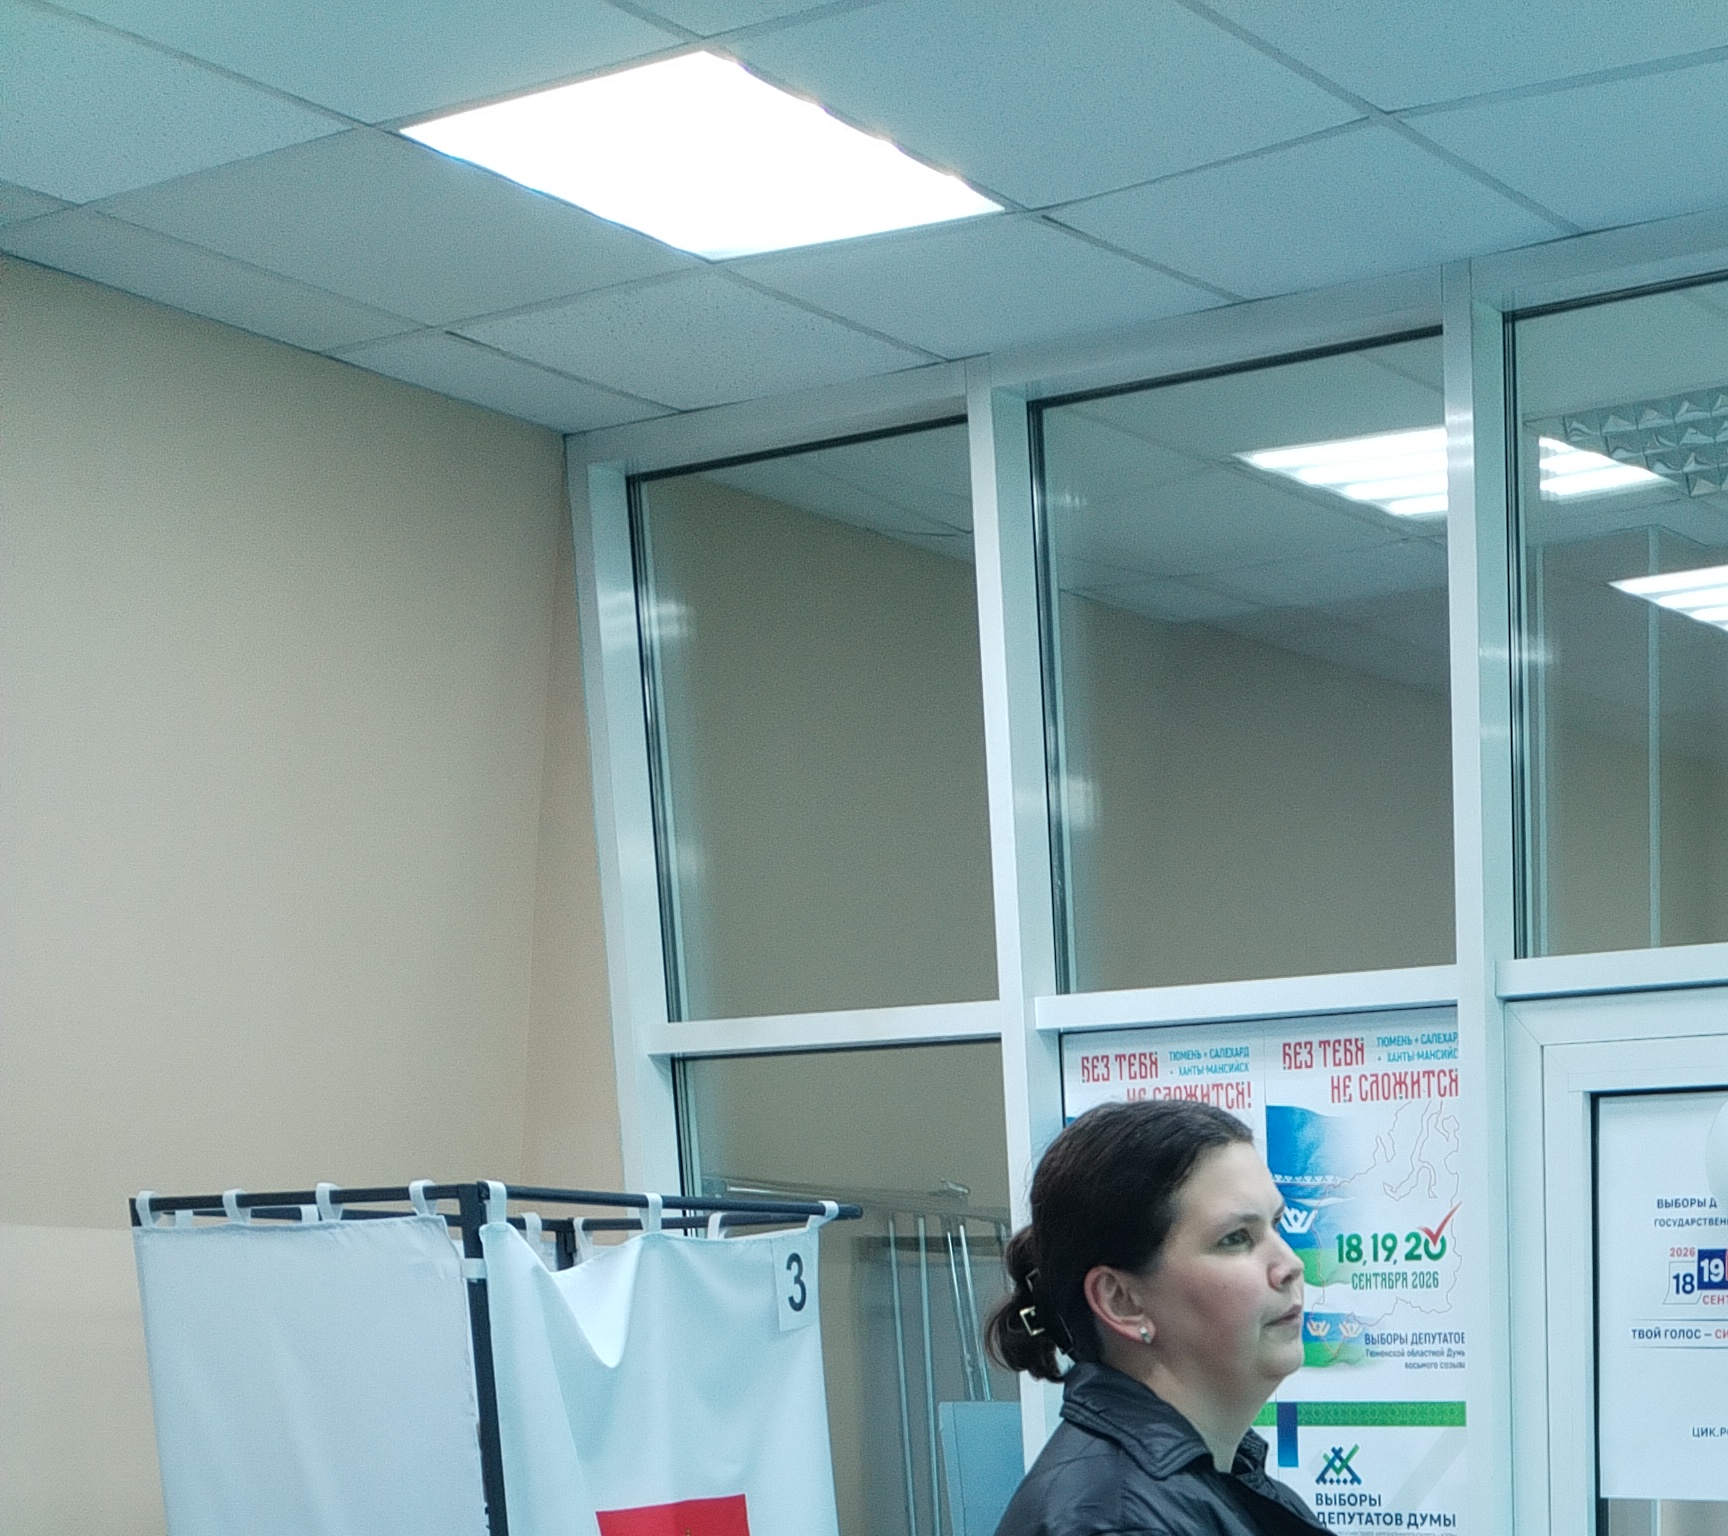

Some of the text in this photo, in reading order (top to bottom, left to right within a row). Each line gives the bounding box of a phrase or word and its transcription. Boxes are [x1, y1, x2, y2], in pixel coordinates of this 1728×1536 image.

[1376, 1034, 1412, 1048] ТЮМЕНЬ
[1420, 1031, 1459, 1045] САЛЕХАР
[1168, 1049, 1202, 1062] ТЮМЕНЬ
[1209, 1046, 1250, 1060] САЛЕХАРД
[1282, 1037, 1365, 1070] БЕЗ ТЕБЯ
[1081, 1051, 1159, 1083] БЕЗ ТЕБЯ
[1178, 1062, 1250, 1077] ХАНТЫ-МАНСИЙСК
[1331, 1074, 1353, 1104] НЕ
[1656, 1198, 1707, 1209] ВЫБОРЫ
[1404, 1231, 1447, 1261] 20
[1669, 1247, 1696, 1257] 2026
[786, 1252, 807, 1312] 3
[1352, 1271, 1440, 1291] СЕНТЯБРЯ 2026
[1672, 1272, 1695, 1295] 18
[1700, 1258, 1725, 1282] 19
[1364, 1332, 1408, 1345] ВЫБОРЫ
[1631, 1326, 1661, 1339] ТВОЙ
[1664, 1329, 1702, 1339] ГОЛОС
[1315, 1493, 1382, 1507] ВЫБОРЫ
[1315, 1512, 1457, 1530] ДЕПУТАТОВ ДУМЫ
